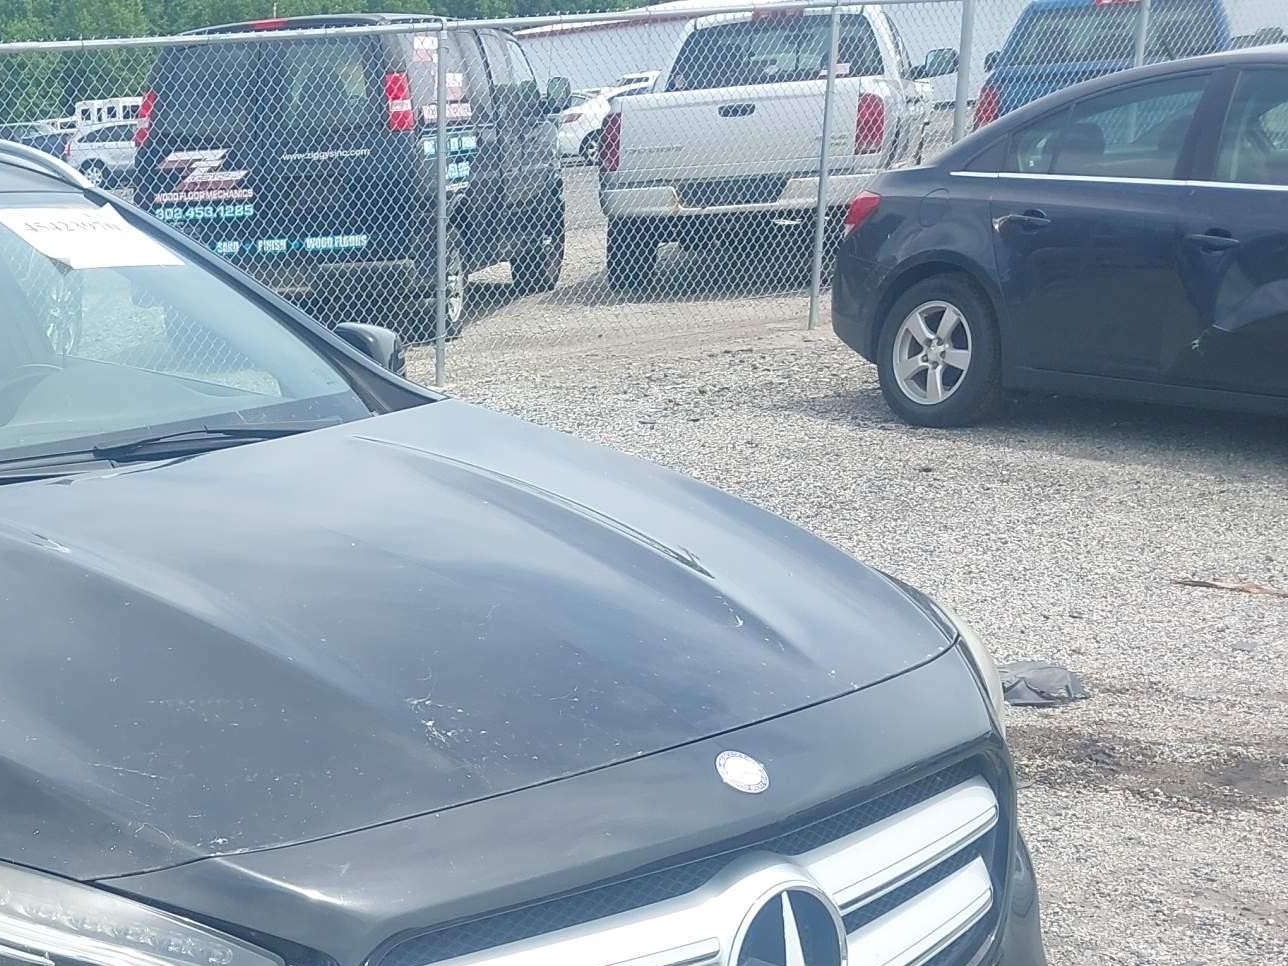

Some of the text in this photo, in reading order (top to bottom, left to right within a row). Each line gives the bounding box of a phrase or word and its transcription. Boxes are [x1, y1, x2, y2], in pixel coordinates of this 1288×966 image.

[205, 189, 254, 200] MECHANICS
[155, 204, 254, 219] 302.453.1285
[258, 239, 287, 251] FINISH
